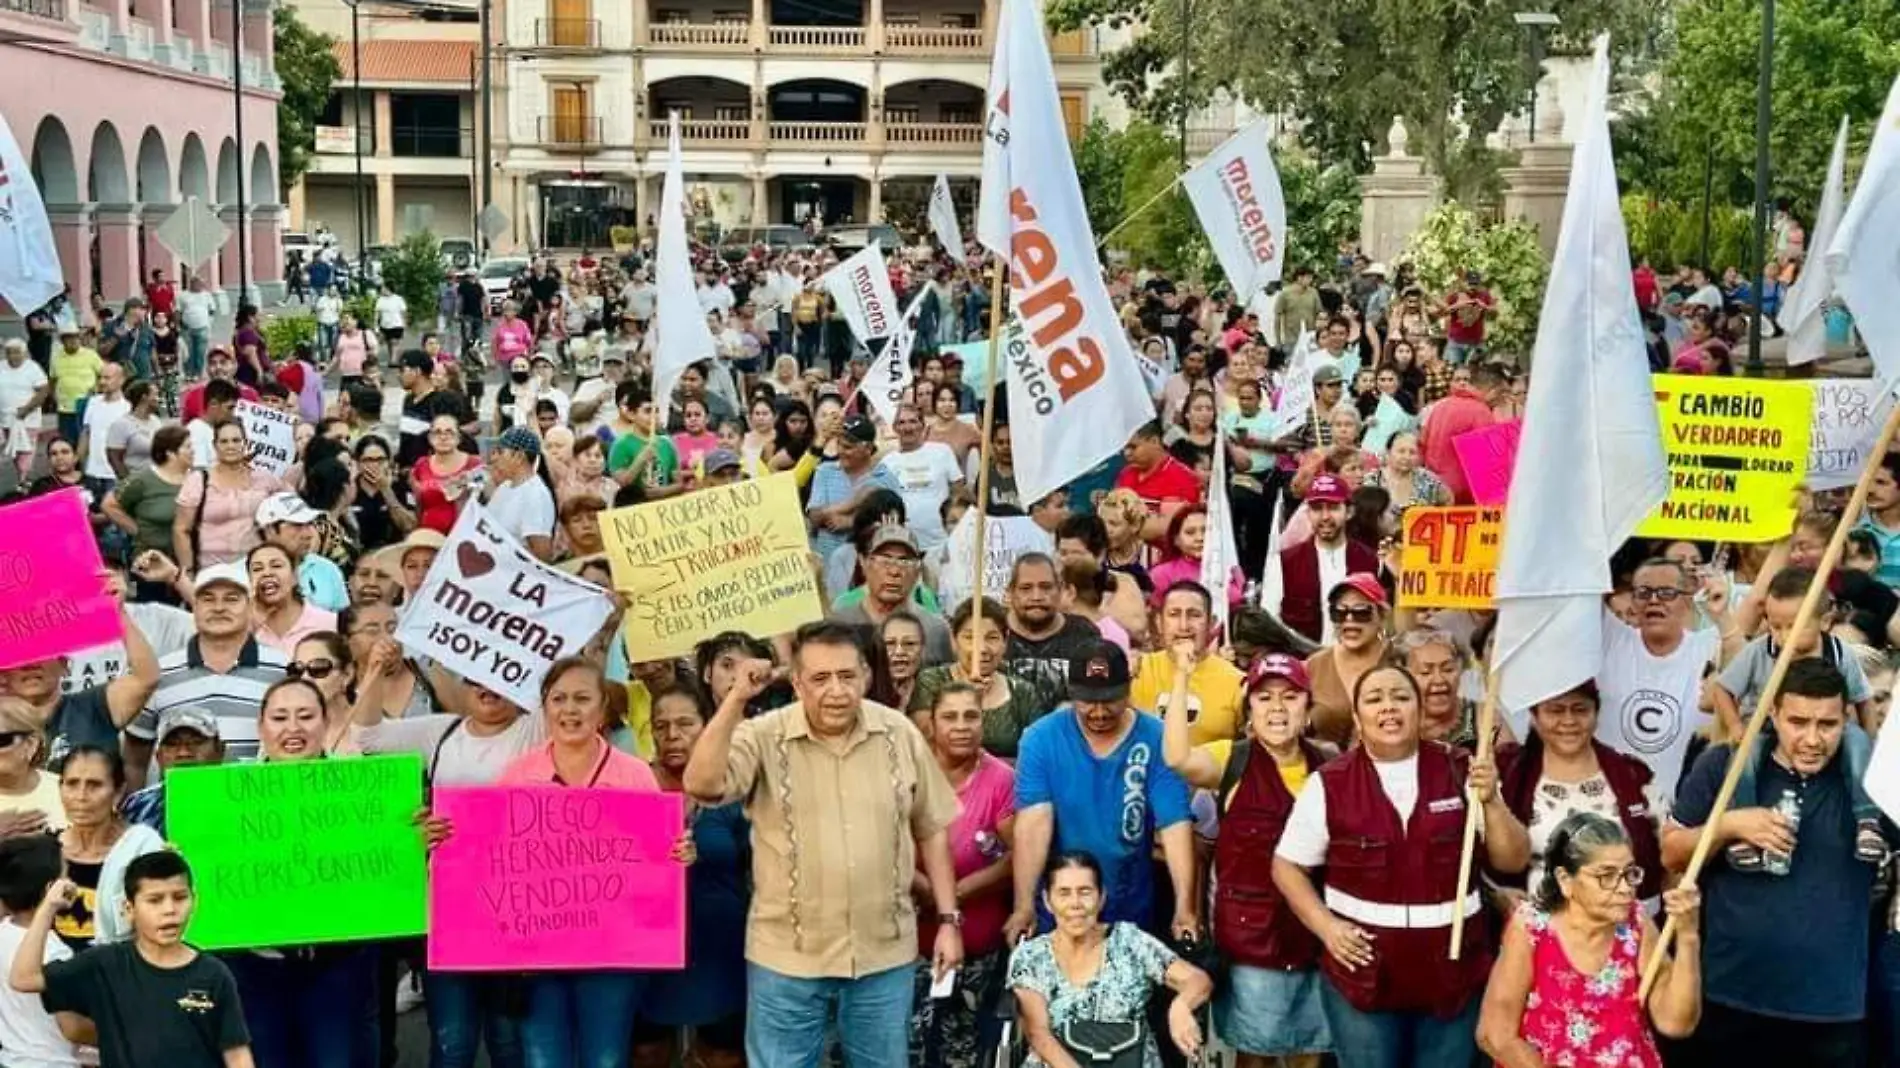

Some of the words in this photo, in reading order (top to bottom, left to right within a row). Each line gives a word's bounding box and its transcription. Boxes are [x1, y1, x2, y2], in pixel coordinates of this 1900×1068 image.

[1225, 156, 1275, 263] morena
[854, 264, 888, 336] morena
[1009, 186, 1106, 406] rena
[248, 440, 288, 461] rena
[252, 422, 270, 437] LA
[1672, 423, 1782, 449] VERDADERO
[1668, 452, 1700, 467] PARA
[1669, 470, 1737, 492] RACIÓN
[613, 512, 648, 542] NO
[729, 483, 762, 511] NO
[625, 530, 694, 567] MENTIR
[699, 525, 714, 543] Y
[720, 515, 750, 540] NO
[657, 535, 767, 581] TRAICIONAR
[509, 571, 547, 608] LA
[1402, 571, 1426, 595] NO
[0, 596, 80, 641] INGAN
[434, 580, 565, 662] morena
[428, 622, 488, 661] ¡SOY
[490, 652, 532, 687] YO!
[241, 809, 284, 845] NO
[509, 788, 602, 838] DIEGO
[479, 873, 624, 915] VENDIDO
